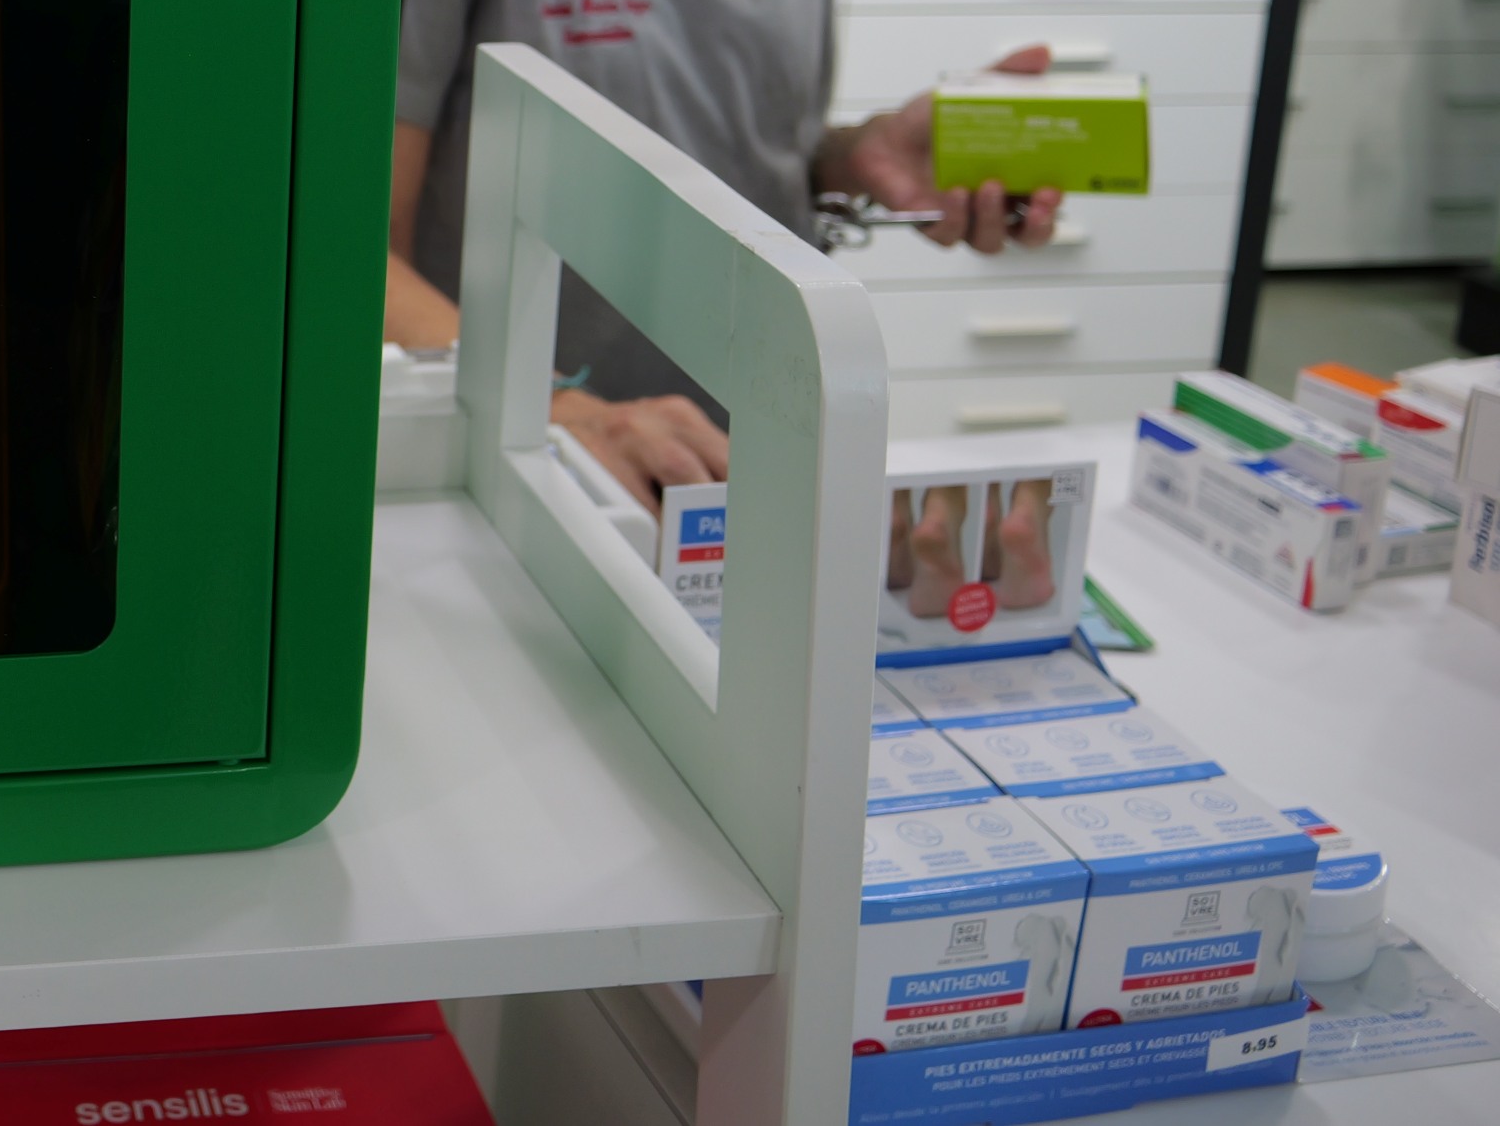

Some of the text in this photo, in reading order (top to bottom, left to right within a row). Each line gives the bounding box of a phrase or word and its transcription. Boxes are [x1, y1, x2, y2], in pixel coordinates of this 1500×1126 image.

[1141, 941, 1243, 968] PANTHENOL
[905, 970, 1011, 998] PANTHENOL
[1130, 981, 1240, 1007] CREMA DE PIES
[895, 1010, 1008, 1038] CREMA DE PIES
[924, 1062, 956, 1079] PIES
[958, 1046, 1087, 1076] EXTREMADAMENTE
[1090, 1040, 1132, 1058] SECOS
[1135, 1038, 1144, 1051] Y
[965, 1076, 987, 1088] LES
[74, 1087, 250, 1125] sensilis
